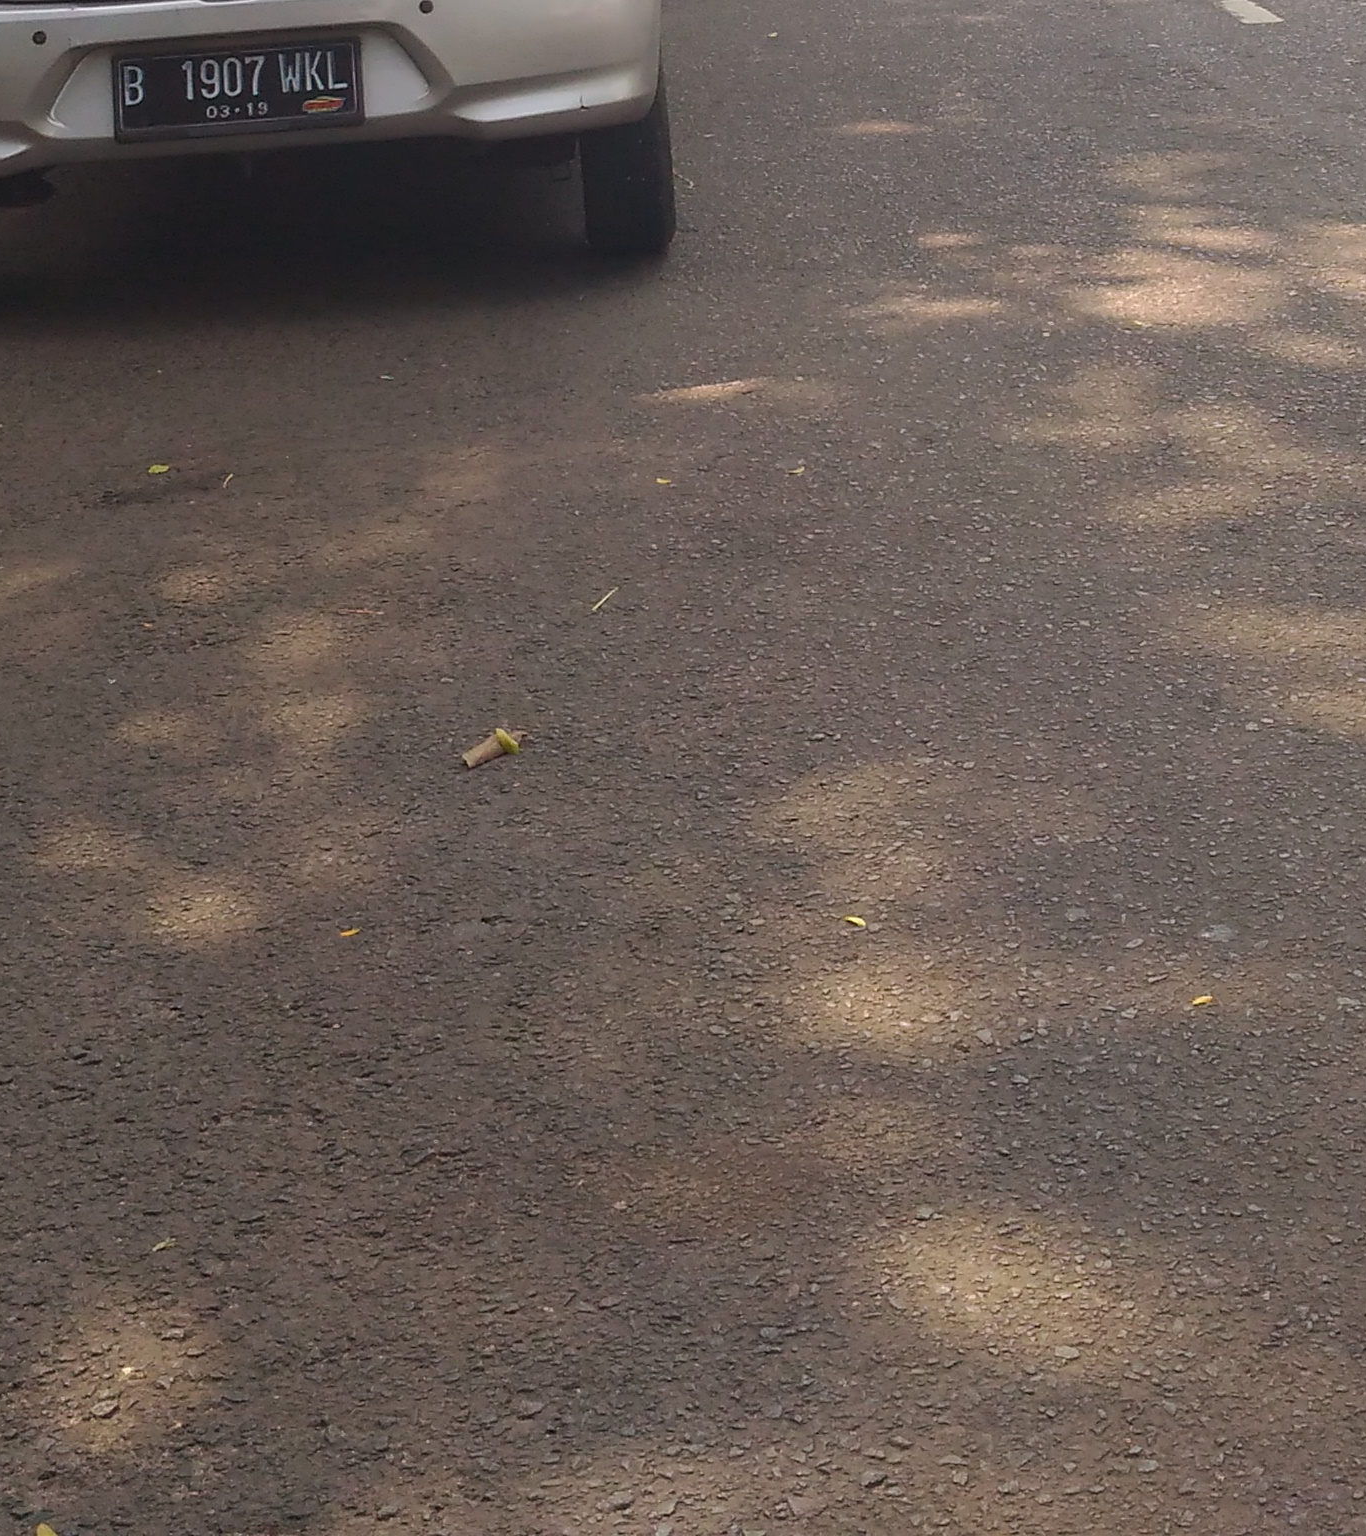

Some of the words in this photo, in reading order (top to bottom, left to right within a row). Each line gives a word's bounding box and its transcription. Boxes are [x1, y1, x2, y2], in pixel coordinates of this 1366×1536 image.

[123, 65, 145, 107] B
[181, 55, 265, 101] 1907
[278, 50, 348, 94] WKL
